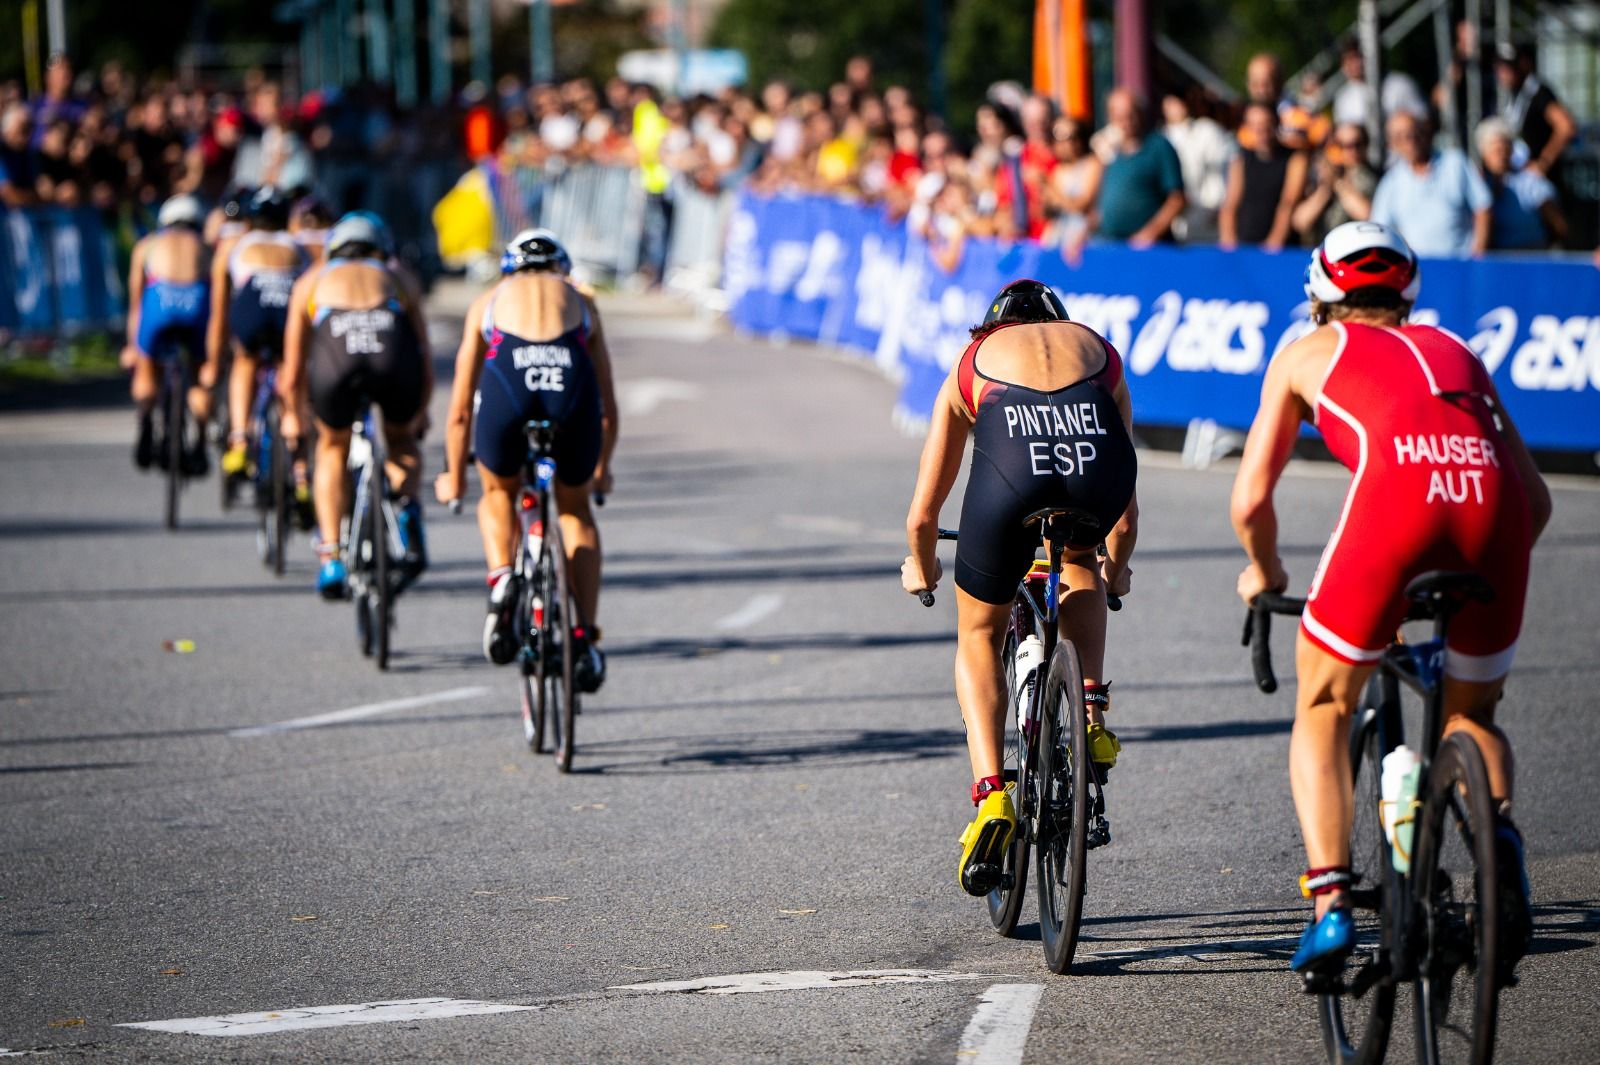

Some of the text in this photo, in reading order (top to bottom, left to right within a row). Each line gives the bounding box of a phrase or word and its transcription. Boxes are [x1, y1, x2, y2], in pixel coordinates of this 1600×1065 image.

[524, 366, 565, 391] CZE
[1004, 403, 1107, 438] PINTANEL
[1029, 441, 1096, 476] ESP
[1394, 434, 1499, 468] HAUSER
[1426, 470, 1483, 504] AUT
